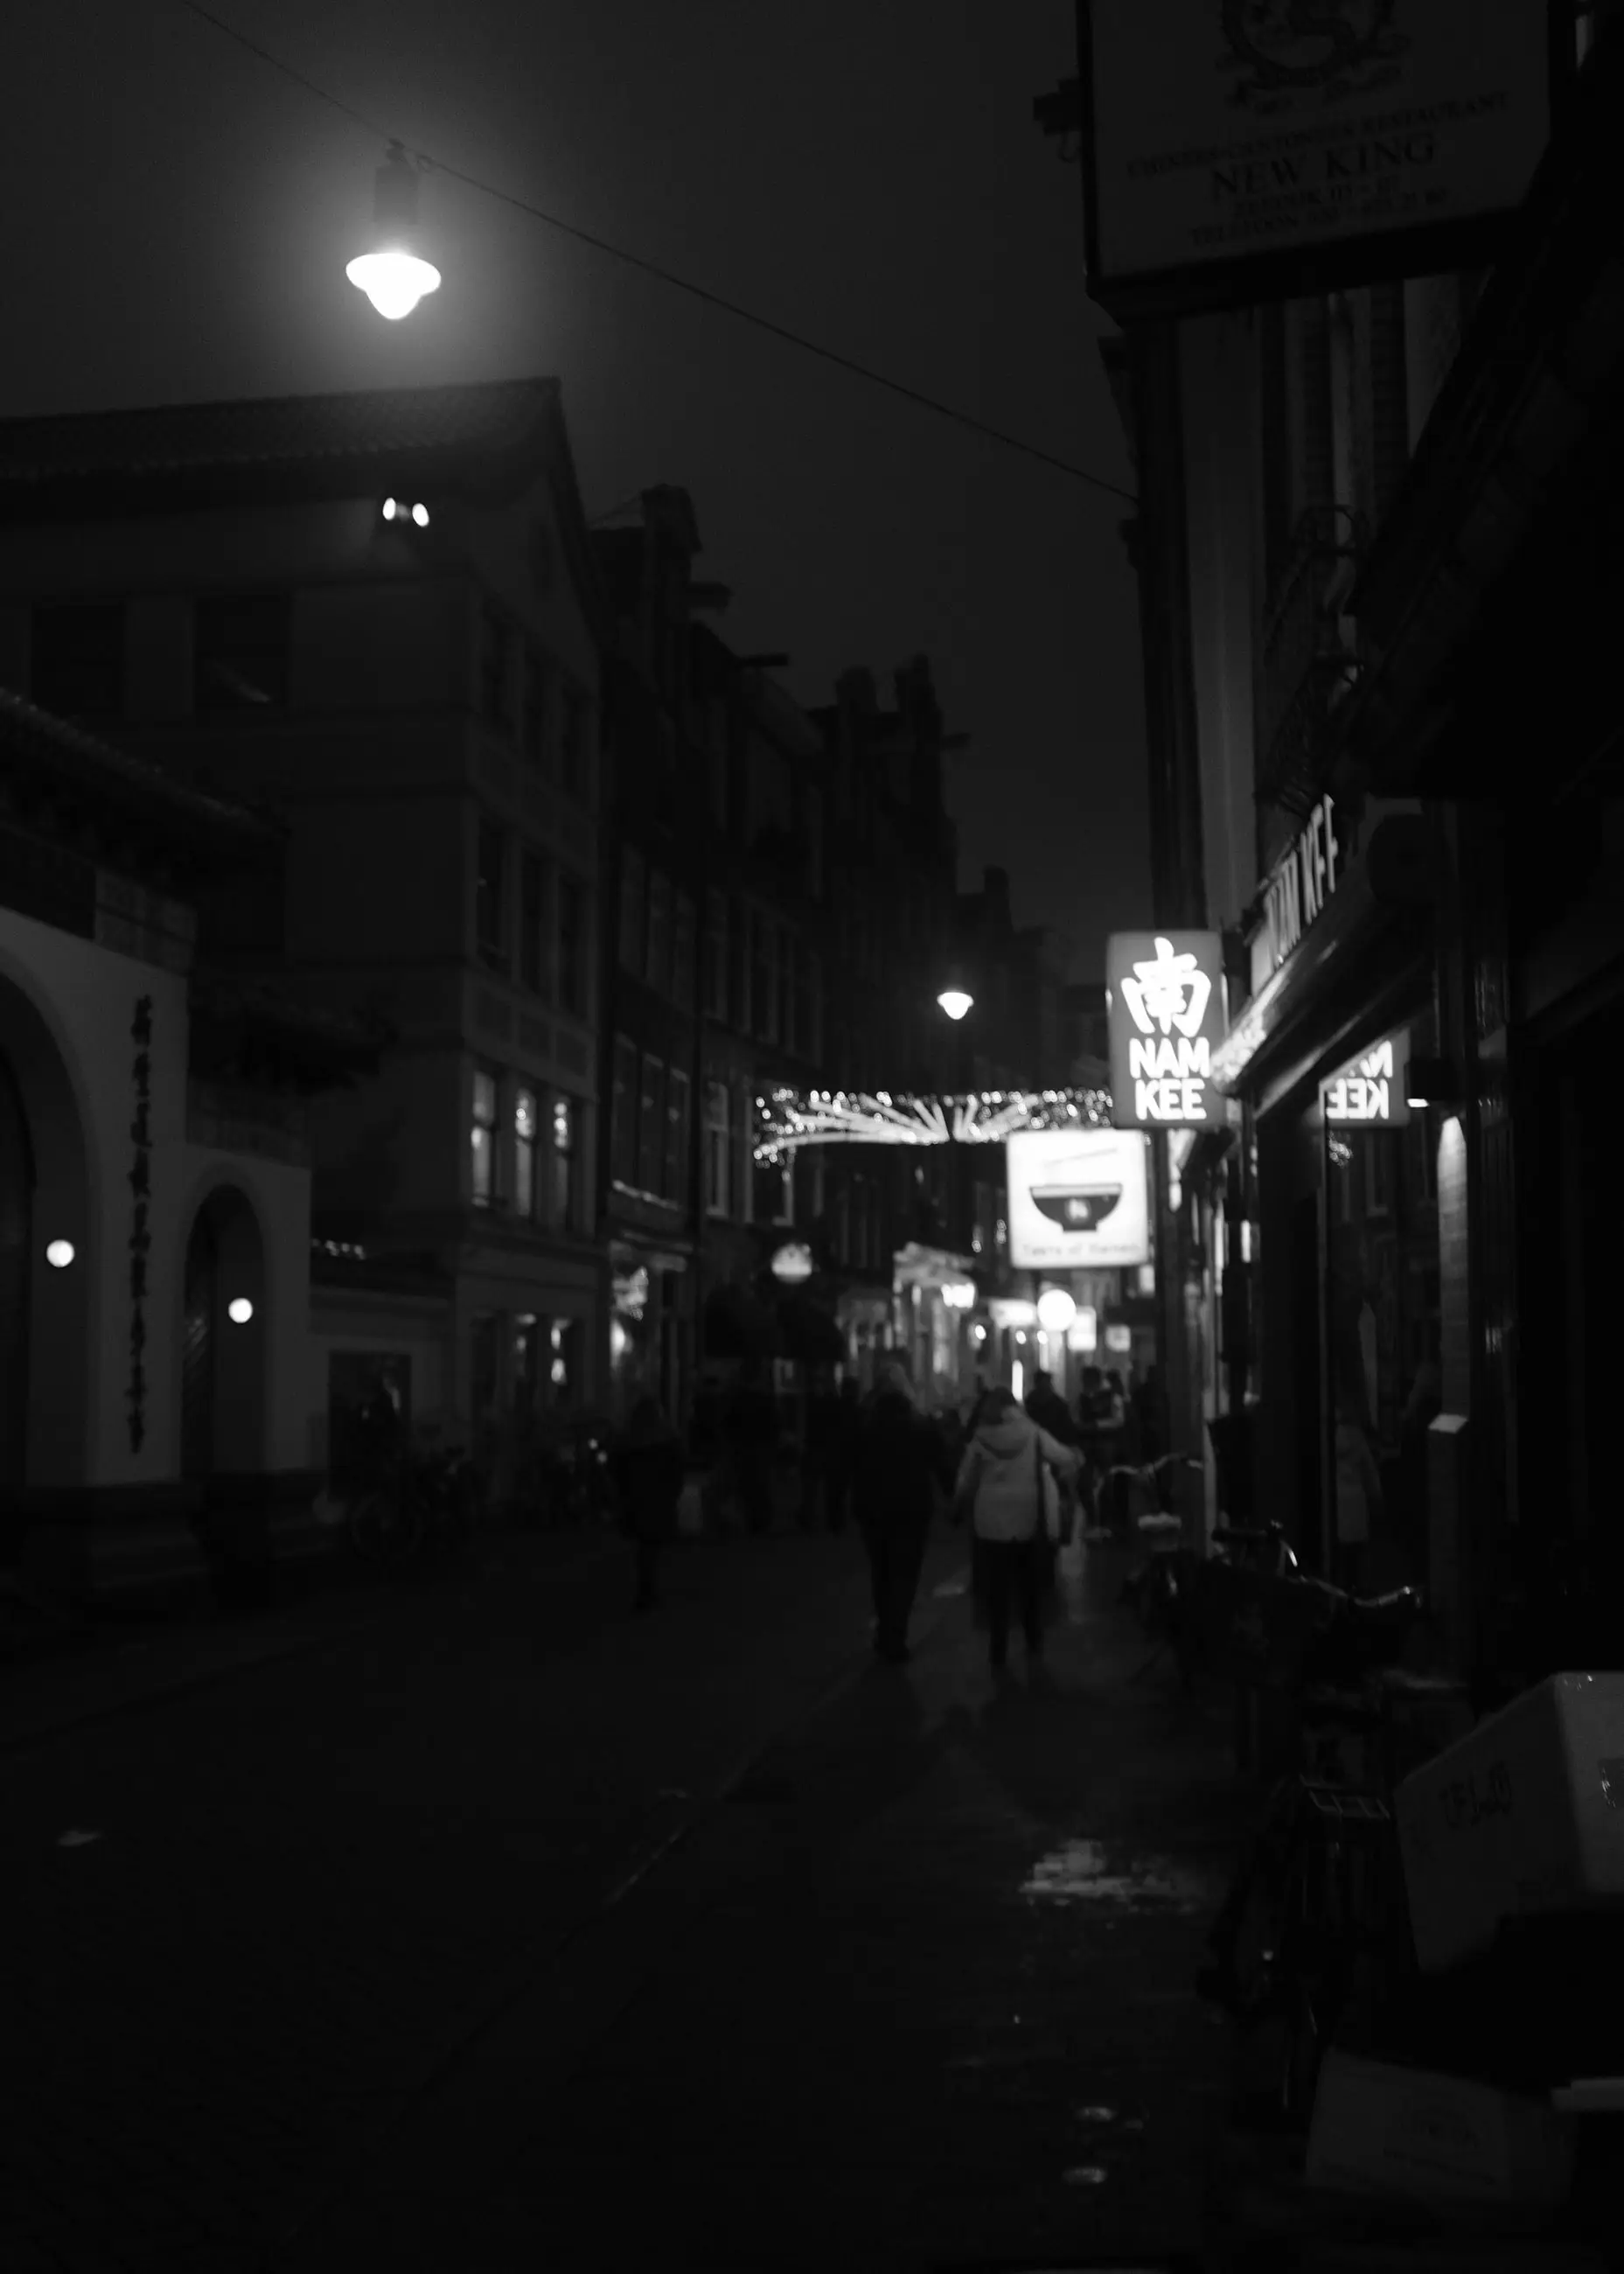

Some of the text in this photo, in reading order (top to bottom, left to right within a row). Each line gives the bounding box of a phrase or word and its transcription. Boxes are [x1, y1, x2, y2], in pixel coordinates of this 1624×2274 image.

[1359, 91, 1511, 136] RESTAURANT
[1211, 134, 1436, 202] NEW KING
[1129, 1036, 1210, 1079] NAM
[1135, 1078, 1207, 1120] KEE
